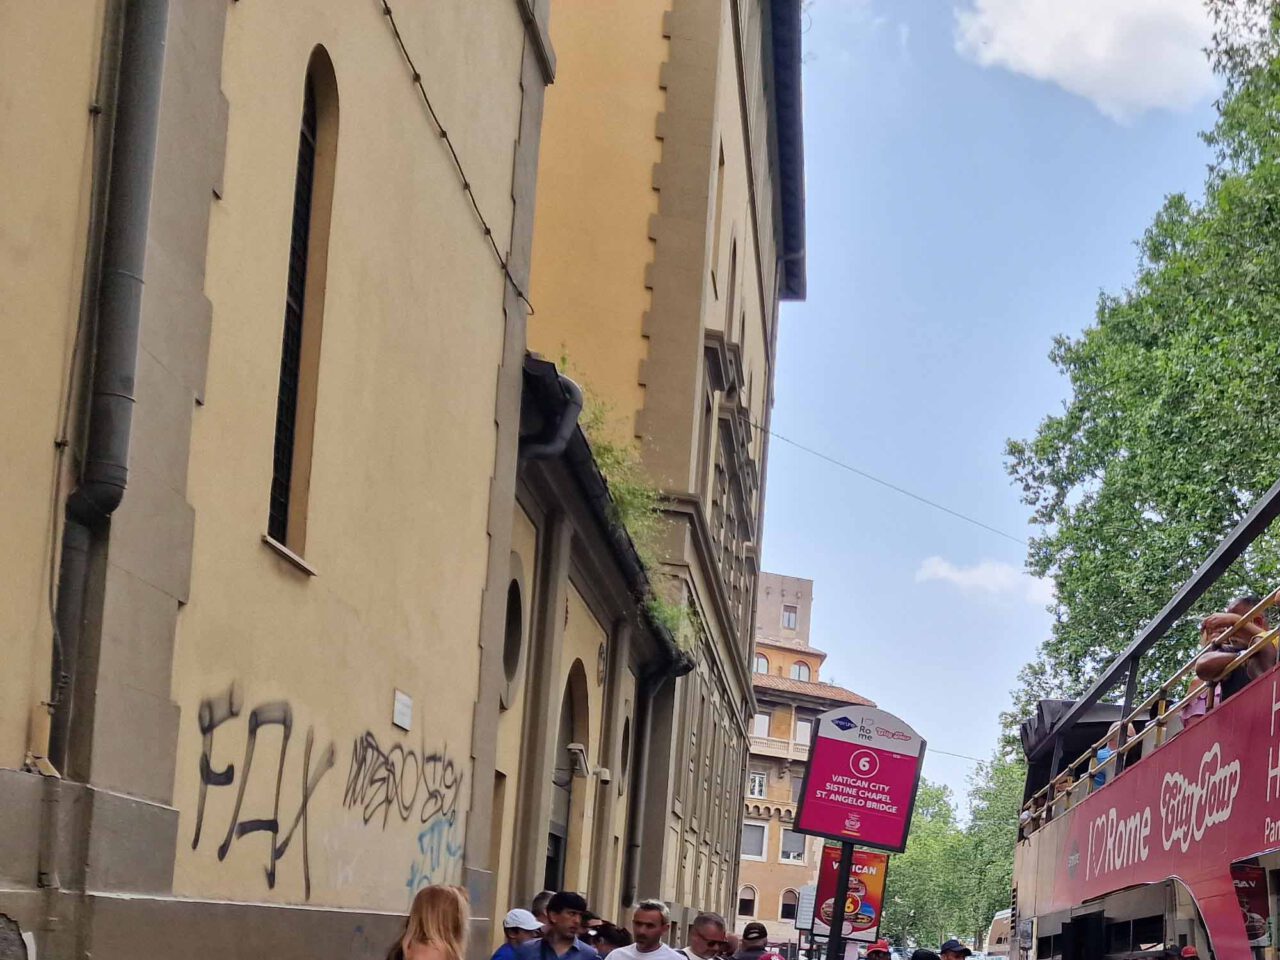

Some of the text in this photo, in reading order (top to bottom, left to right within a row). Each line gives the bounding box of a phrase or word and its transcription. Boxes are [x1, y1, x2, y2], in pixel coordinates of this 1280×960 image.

[859, 757, 870, 771] 6
[832, 774, 890, 792] VATICAN CITY
[825, 783, 891, 802] SISTINE CHAPEL
[816, 791, 898, 813] ST. ANGELO BRIDGE
[1105, 806, 1151, 873] Rome
[832, 861, 877, 875] VICAN
